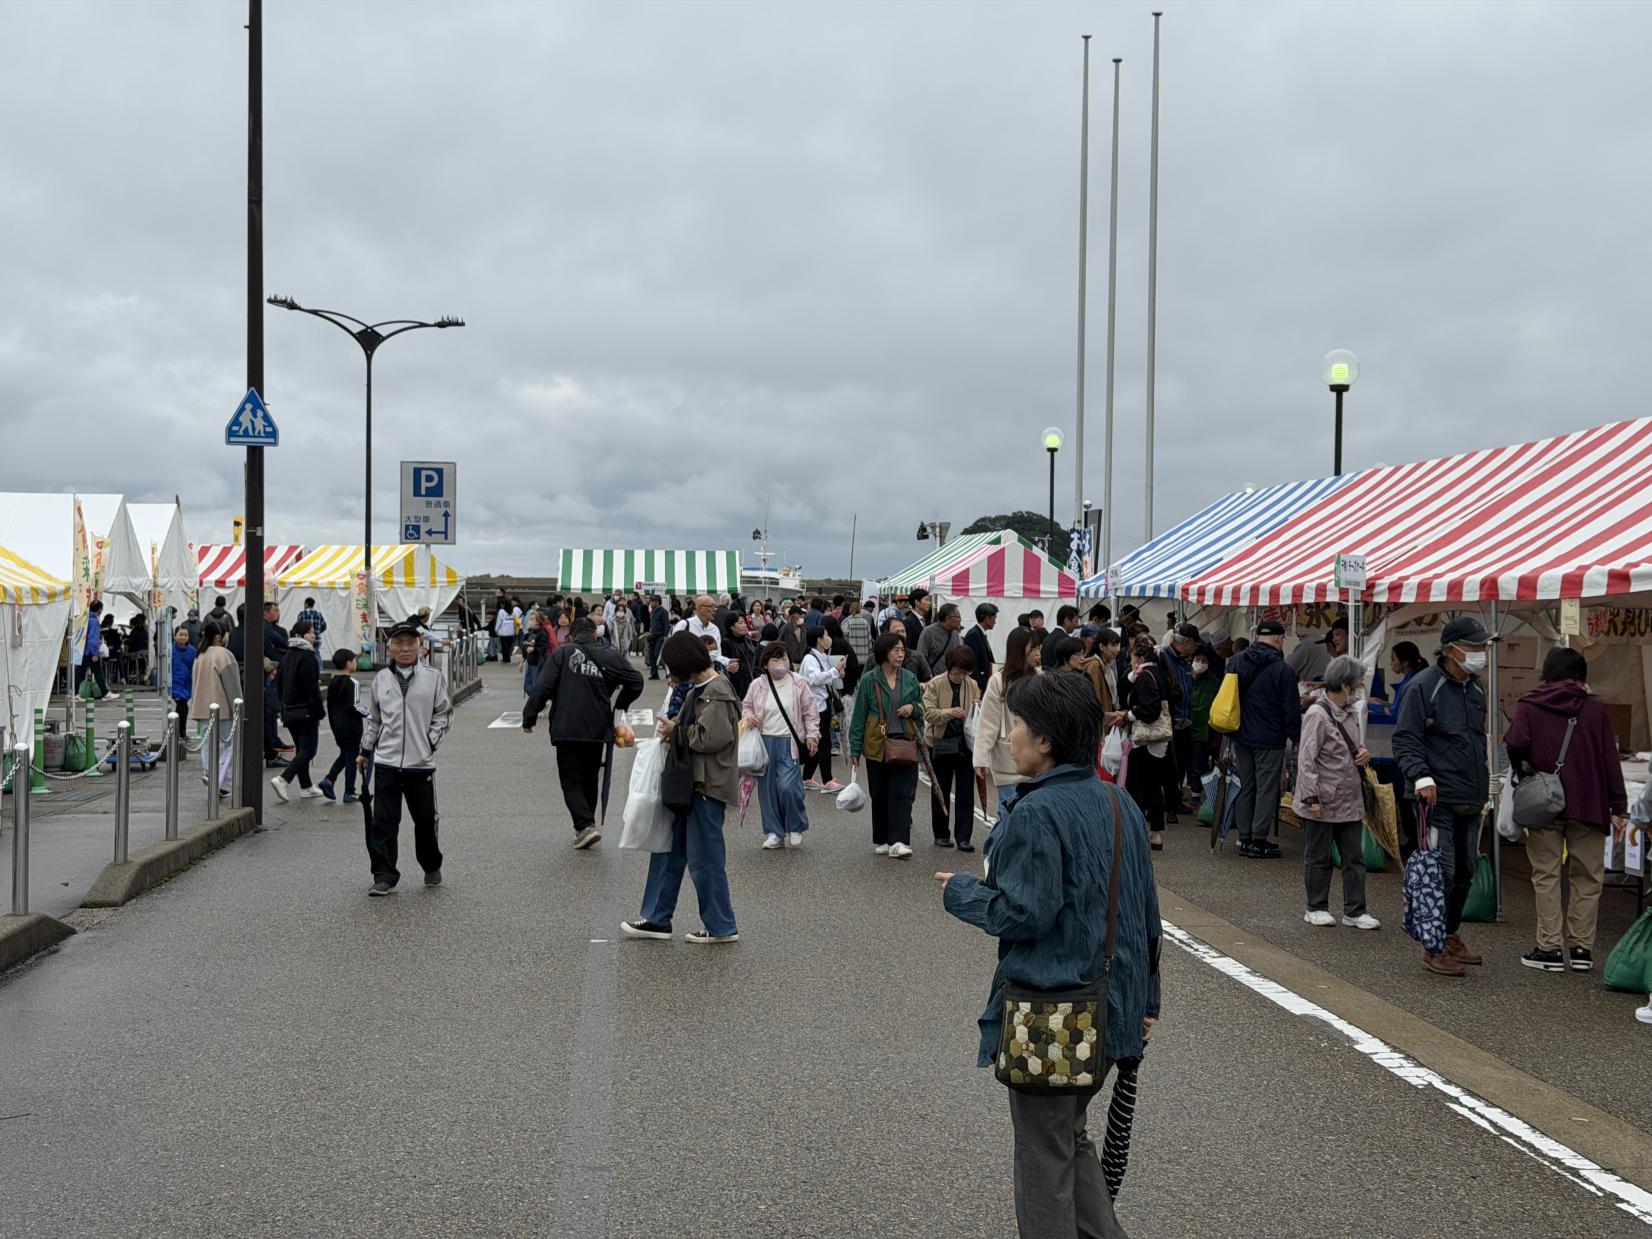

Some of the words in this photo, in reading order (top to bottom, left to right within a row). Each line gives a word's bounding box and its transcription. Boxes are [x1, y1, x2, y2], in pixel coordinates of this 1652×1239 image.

[421, 470, 438, 495] P
[404, 515, 430, 523] 大型車
